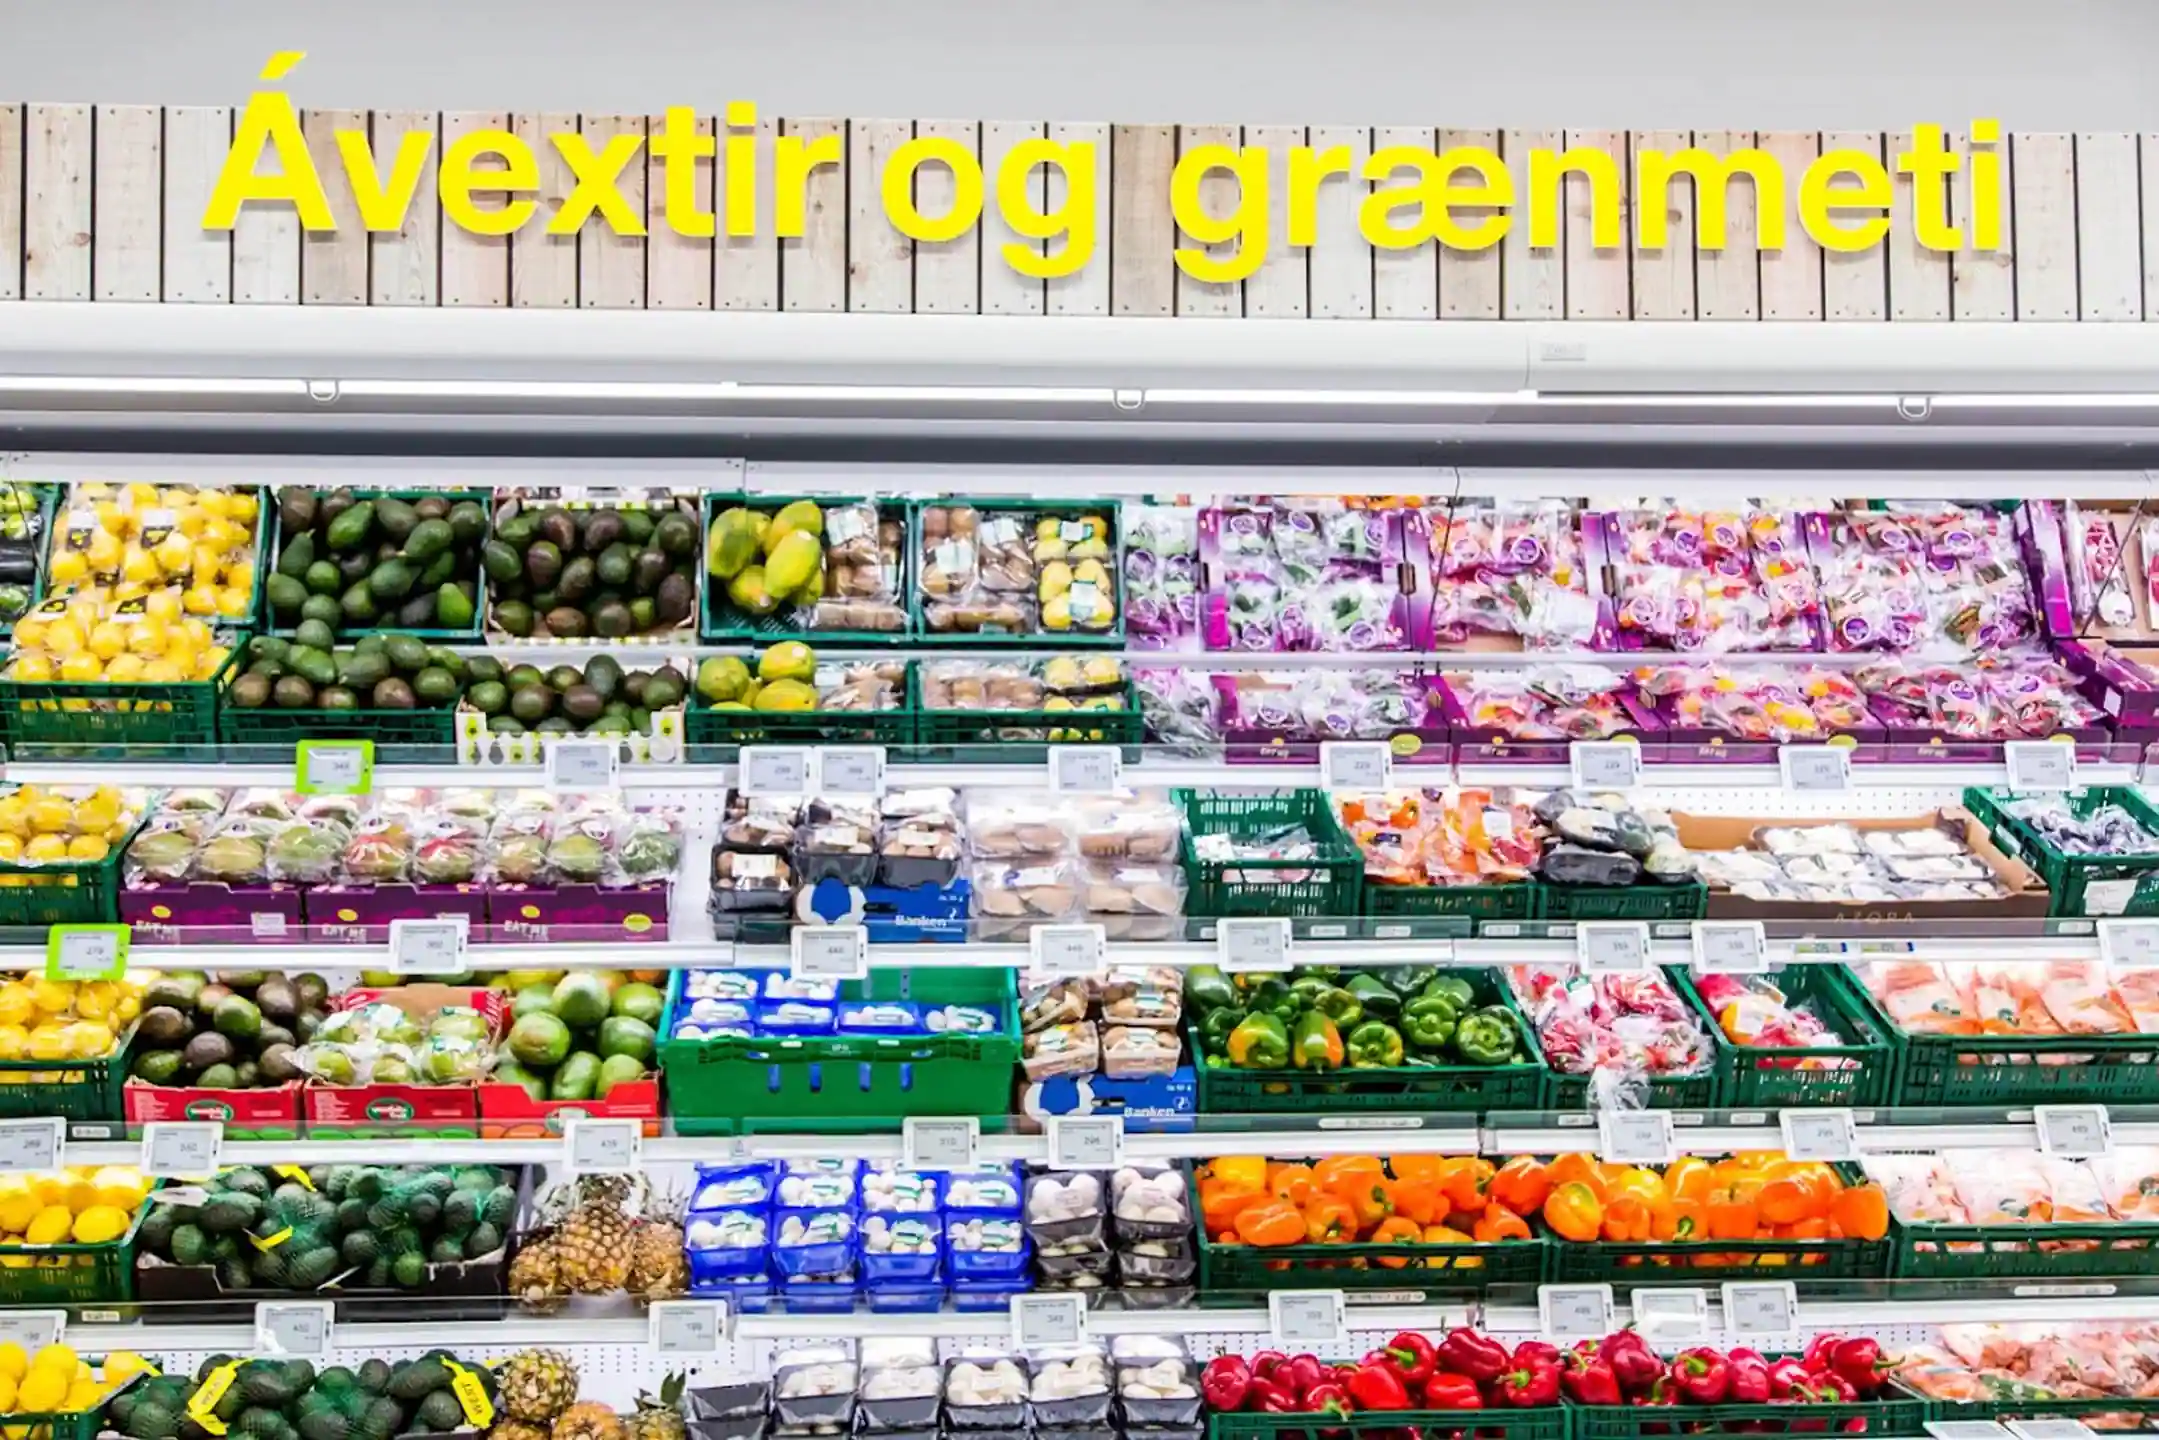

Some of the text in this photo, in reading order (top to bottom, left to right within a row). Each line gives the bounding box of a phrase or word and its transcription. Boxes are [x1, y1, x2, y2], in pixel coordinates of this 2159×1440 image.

[204, 53, 2000, 281] Ávextir og grænmeti
